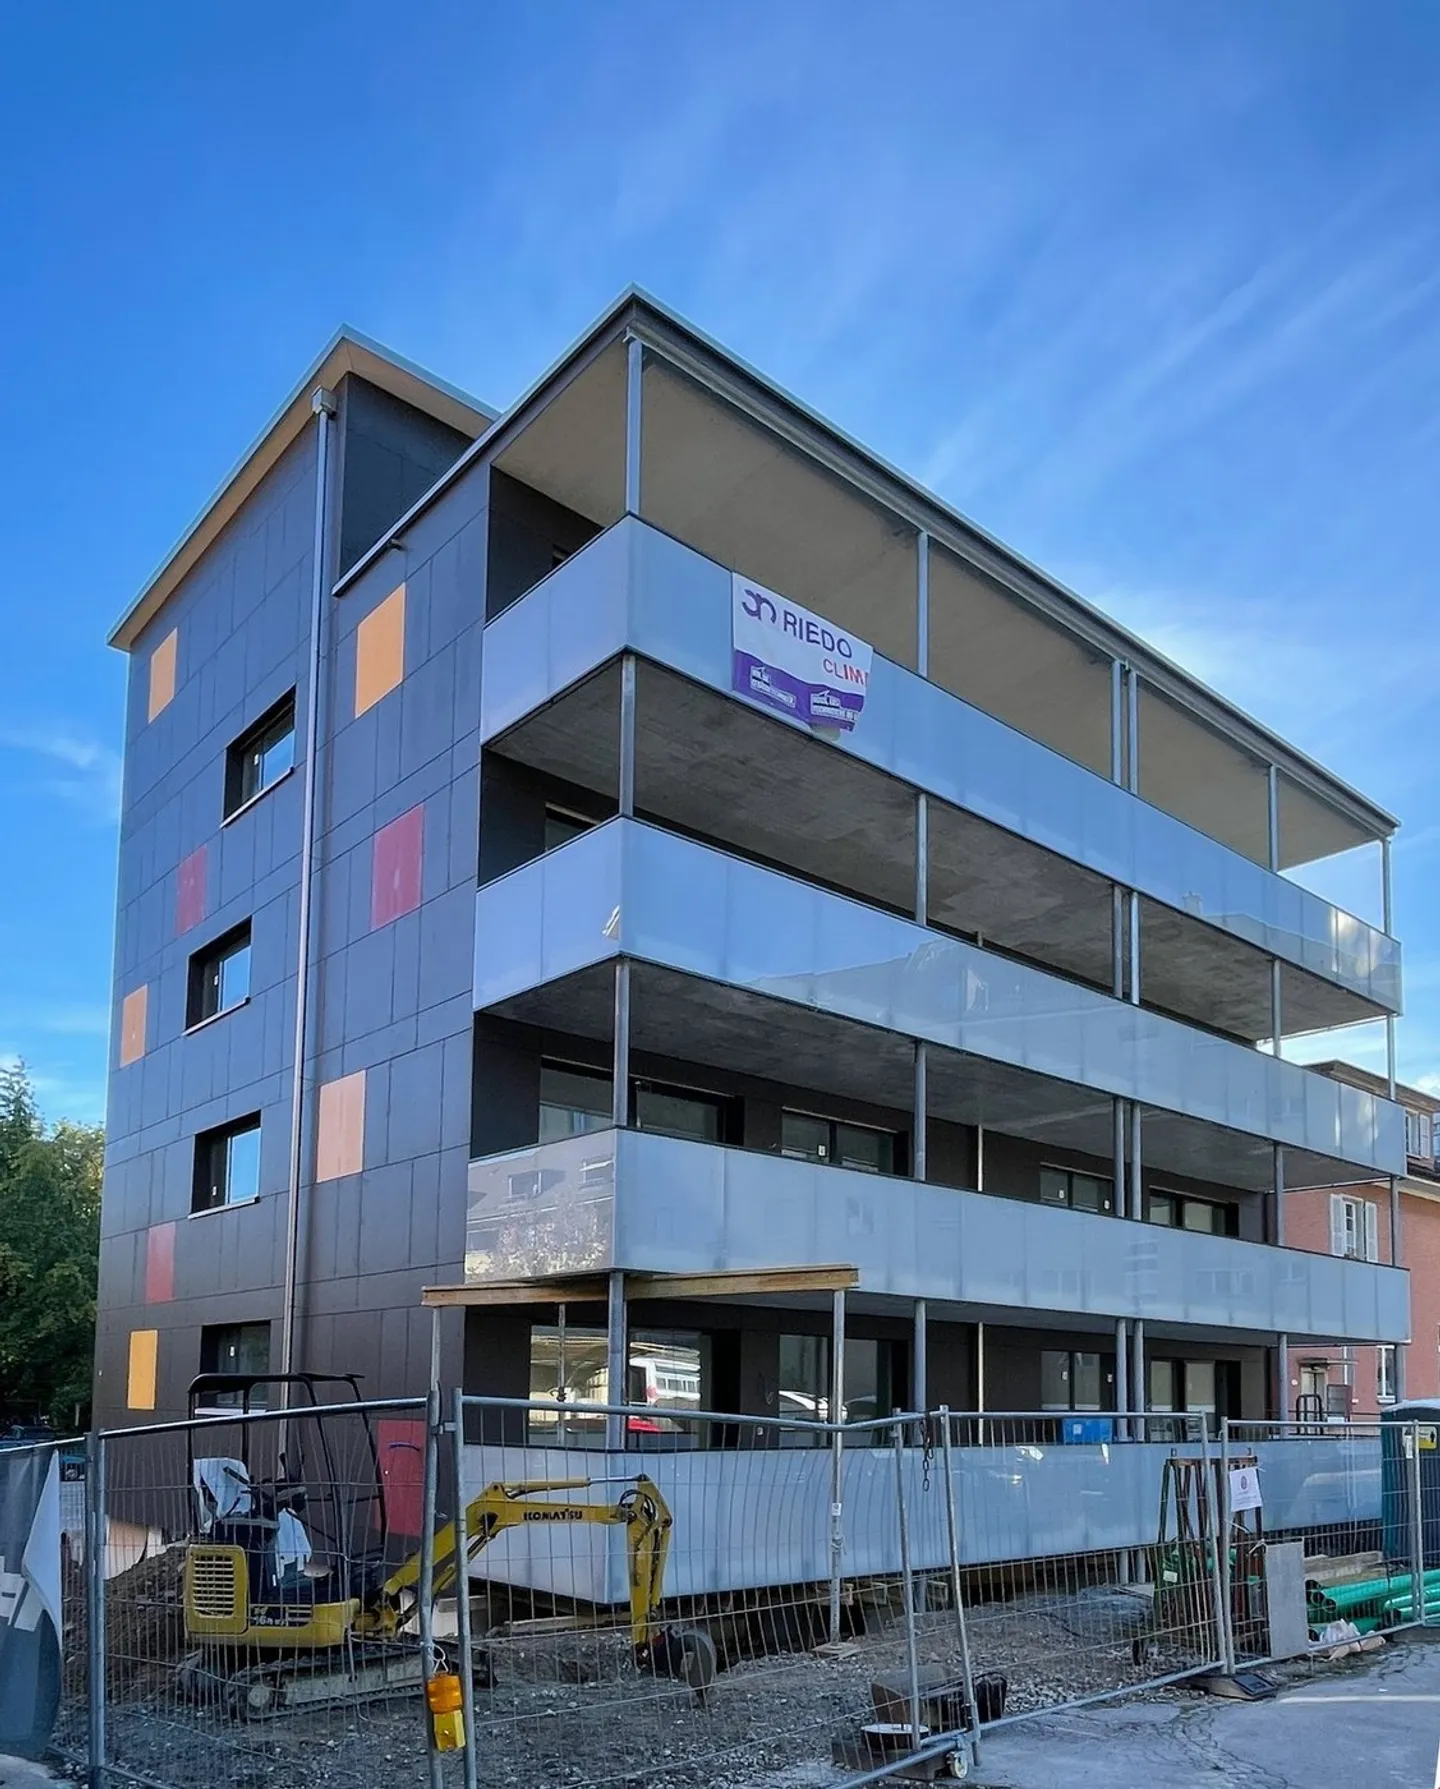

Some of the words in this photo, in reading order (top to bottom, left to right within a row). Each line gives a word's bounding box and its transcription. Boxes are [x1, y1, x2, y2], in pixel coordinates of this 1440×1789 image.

[783, 610, 852, 659] RIEDO
[823, 658, 868, 686] CLIM
[523, 1508, 583, 1521] KOMATSU
